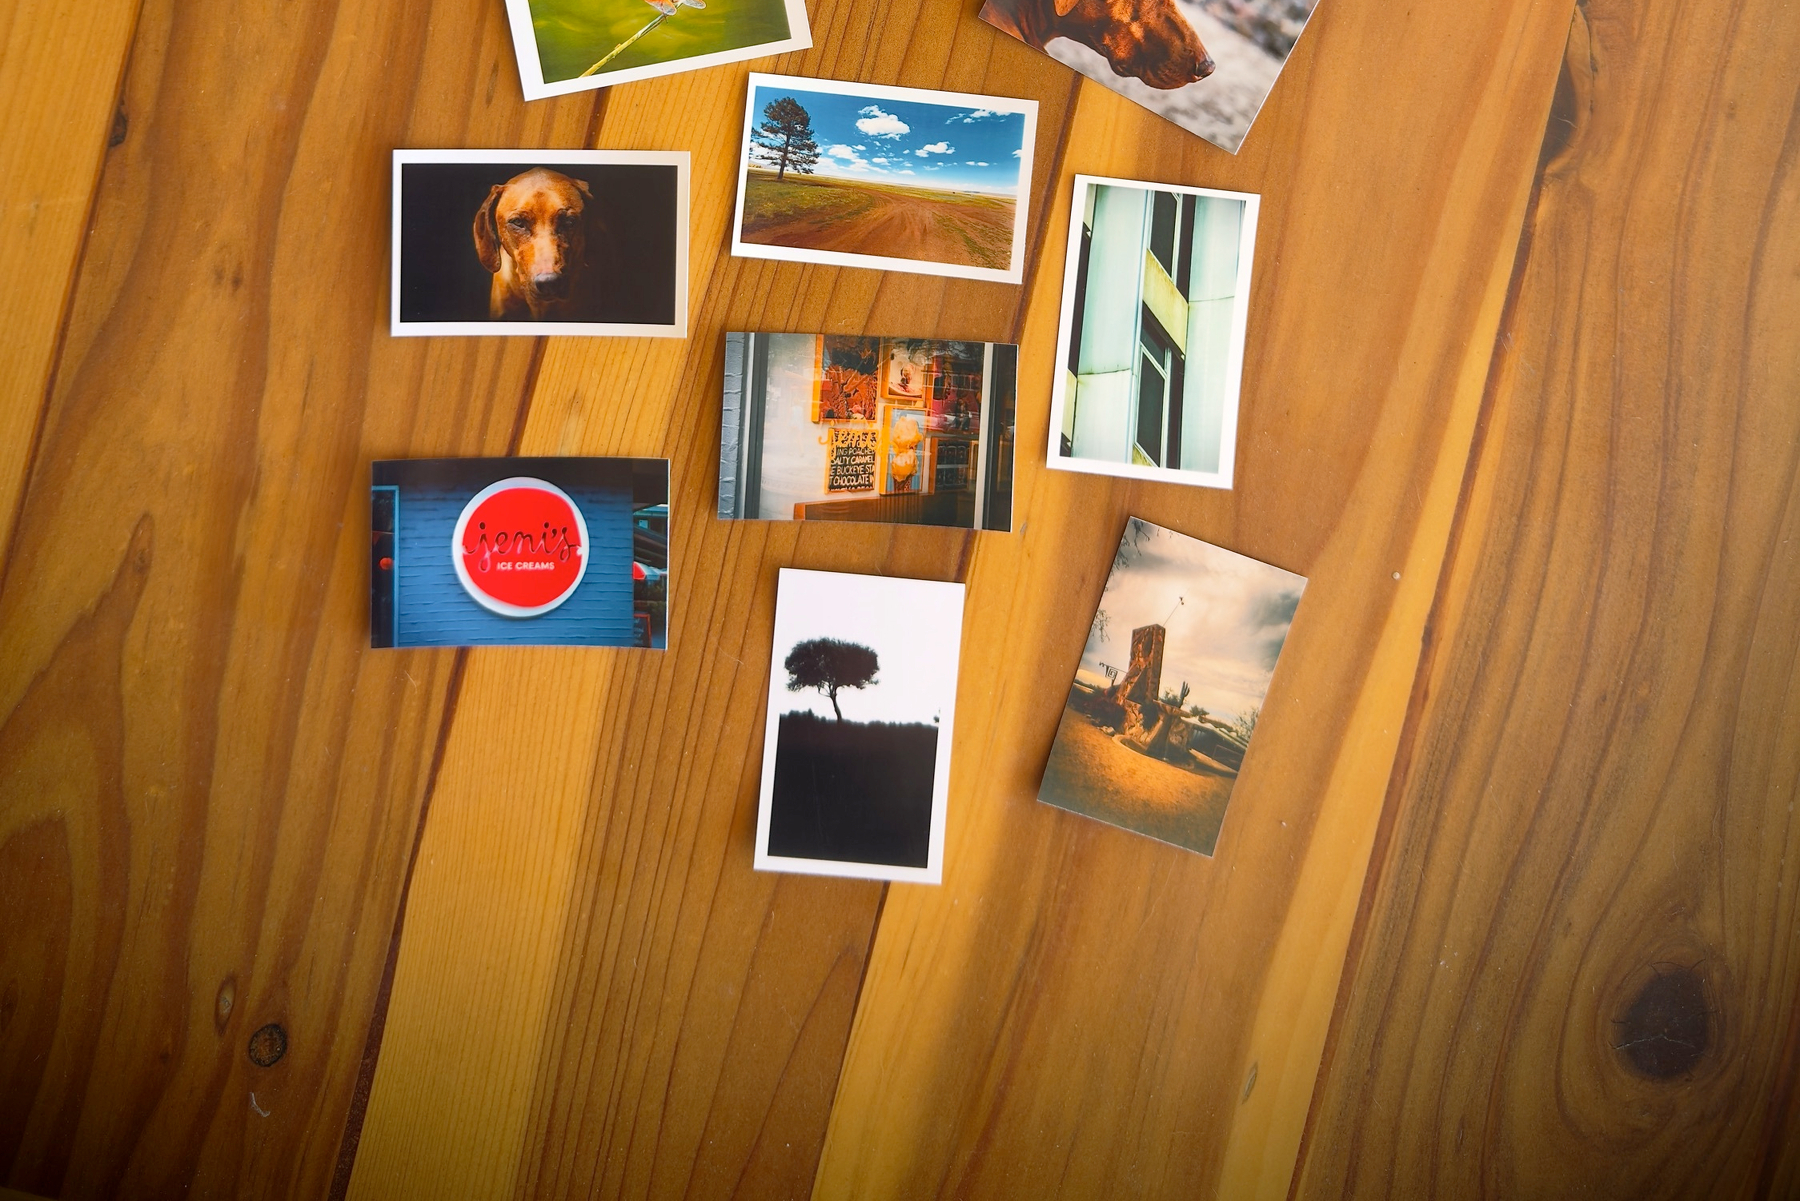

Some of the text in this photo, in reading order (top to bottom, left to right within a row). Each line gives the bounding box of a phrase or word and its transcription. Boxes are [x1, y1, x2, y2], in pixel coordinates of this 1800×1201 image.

[851, 455, 874, 464] CARAMEL
[837, 465, 865, 475] BUCKEYE
[833, 474, 869, 485] CHOCOLATE
[463, 522, 582, 573] jeni's
[496, 561, 555, 571] ICE CREAMS
